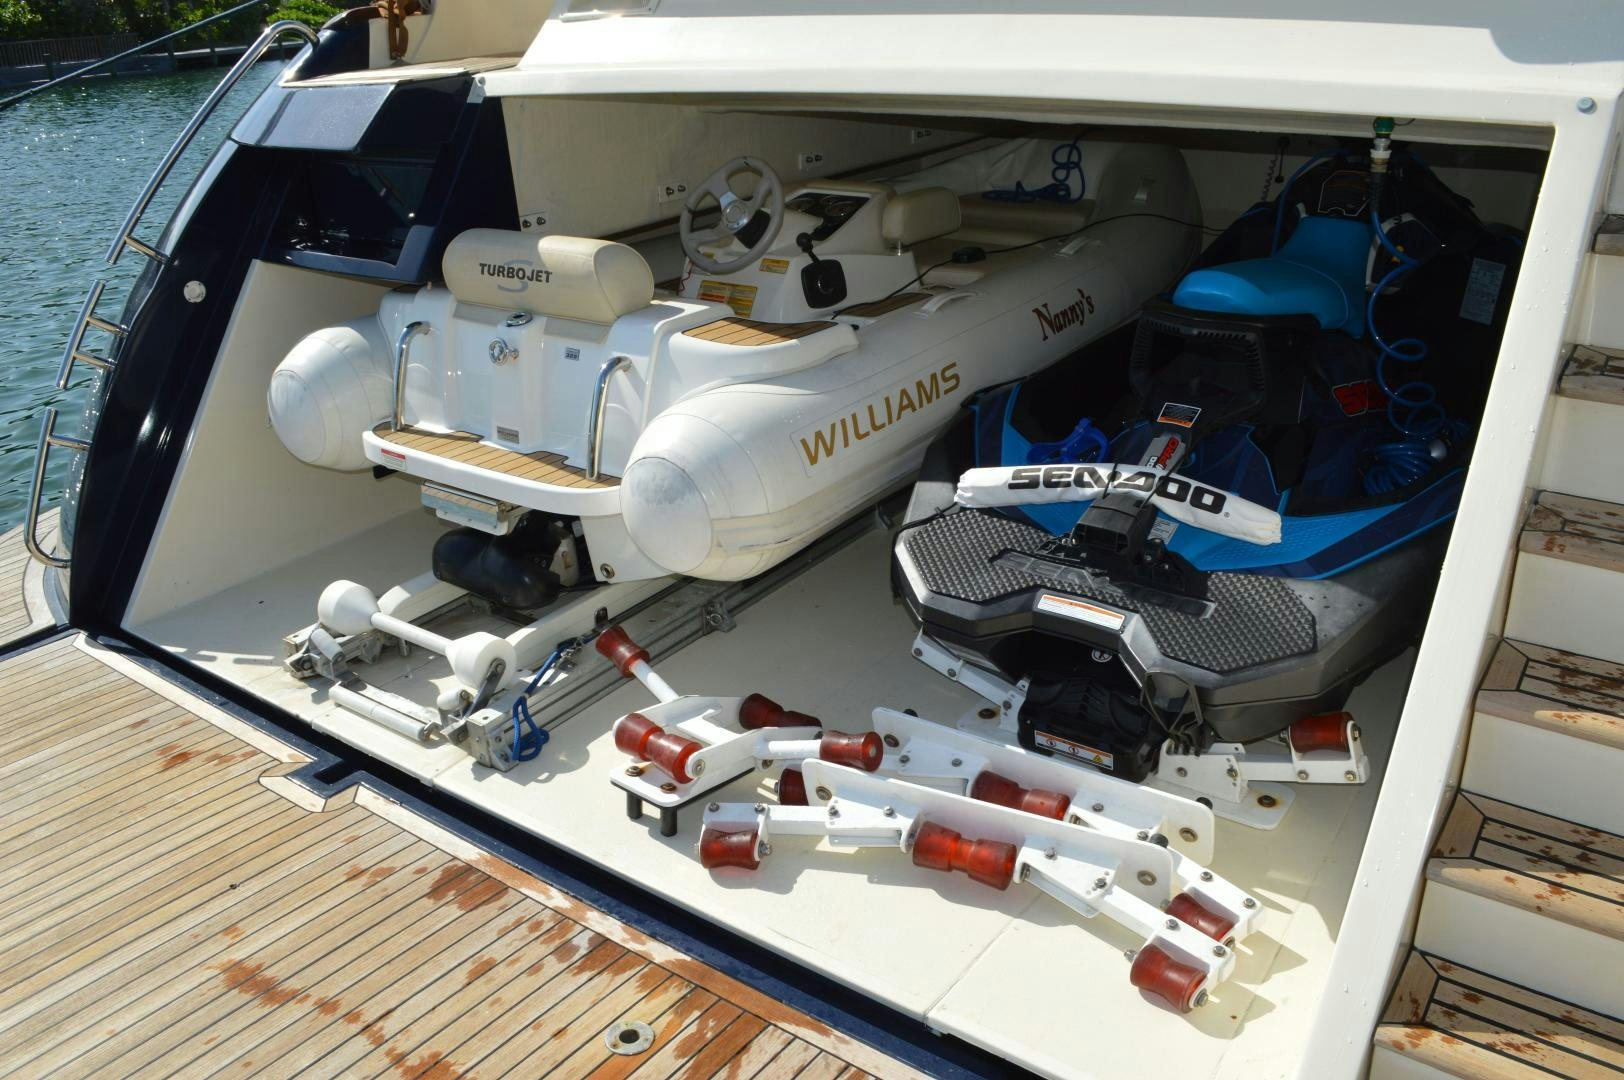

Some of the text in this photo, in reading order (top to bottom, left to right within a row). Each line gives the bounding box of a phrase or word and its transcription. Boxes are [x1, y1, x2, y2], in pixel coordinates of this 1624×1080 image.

[479, 263, 553, 283] TURBOJET
[1031, 288, 1094, 338] Nanny's
[800, 363, 961, 463] WILLIAMS
